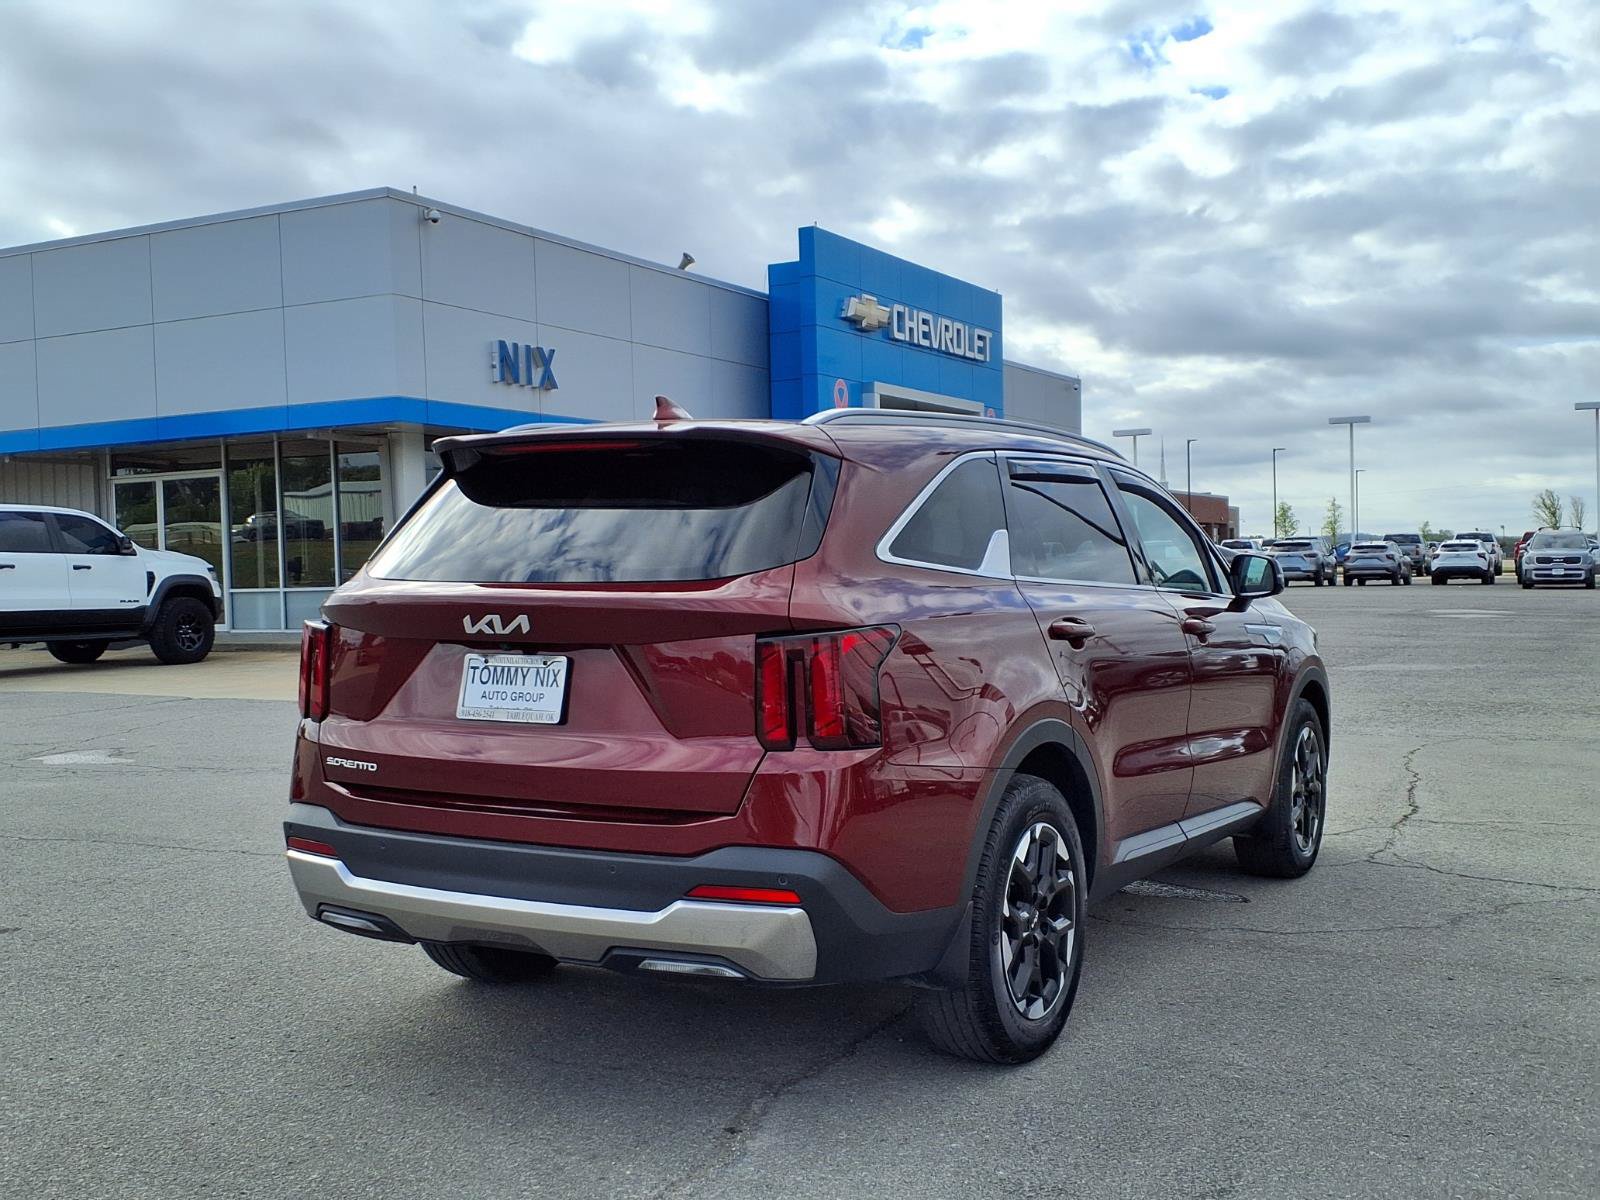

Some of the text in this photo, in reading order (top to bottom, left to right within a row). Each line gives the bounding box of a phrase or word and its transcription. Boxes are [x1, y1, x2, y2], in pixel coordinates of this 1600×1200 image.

[891, 304, 992, 362] CHEVROLET
[493, 339, 558, 390] NIX
[463, 614, 530, 634] KIA
[470, 666, 561, 688] TOMMY NIX
[481, 690, 545, 703] AUTO GROUP
[326, 756, 377, 771] SORENTO
